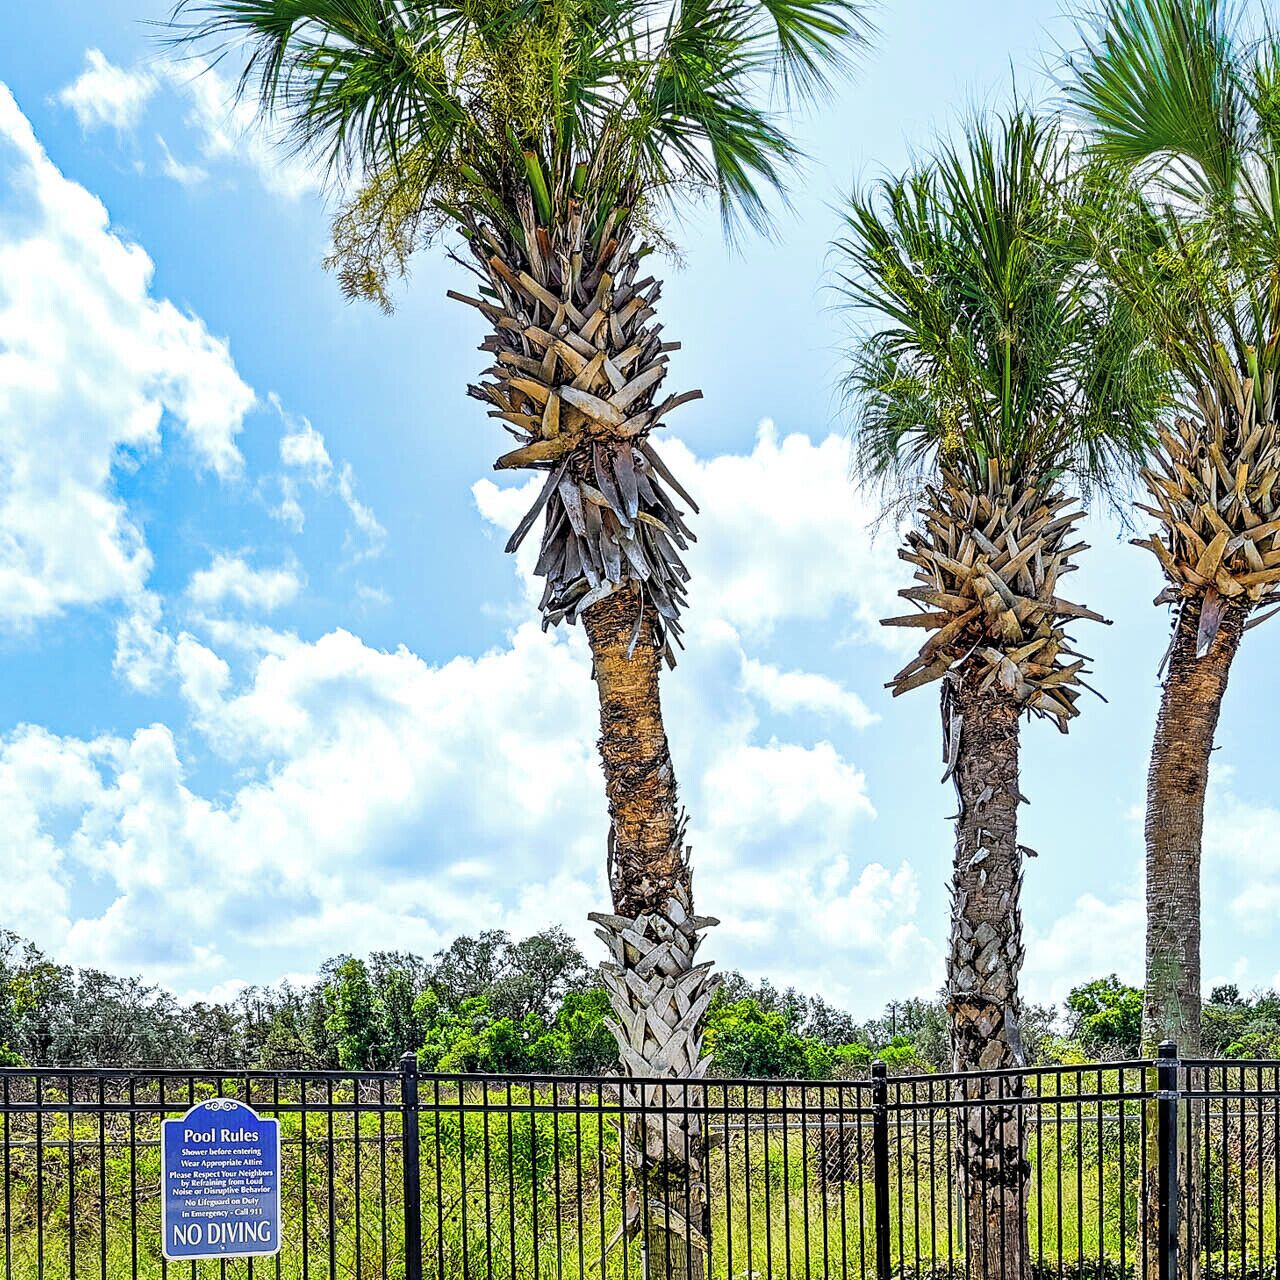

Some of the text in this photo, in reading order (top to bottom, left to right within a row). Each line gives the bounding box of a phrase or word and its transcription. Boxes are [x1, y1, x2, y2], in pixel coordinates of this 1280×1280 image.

[184, 1128, 258, 1142] Pool Rules
[233, 1148, 261, 1156] entering
[201, 1159, 242, 1168] Appropriate
[193, 1171, 220, 1179] Respect
[239, 1170, 273, 1178] Neighbors
[192, 1179, 226, 1187] Refraining
[198, 1198, 230, 1206] Lifeguard
[191, 1210, 228, 1218] Emergency
[174, 1221, 270, 1246] NO DIVING
